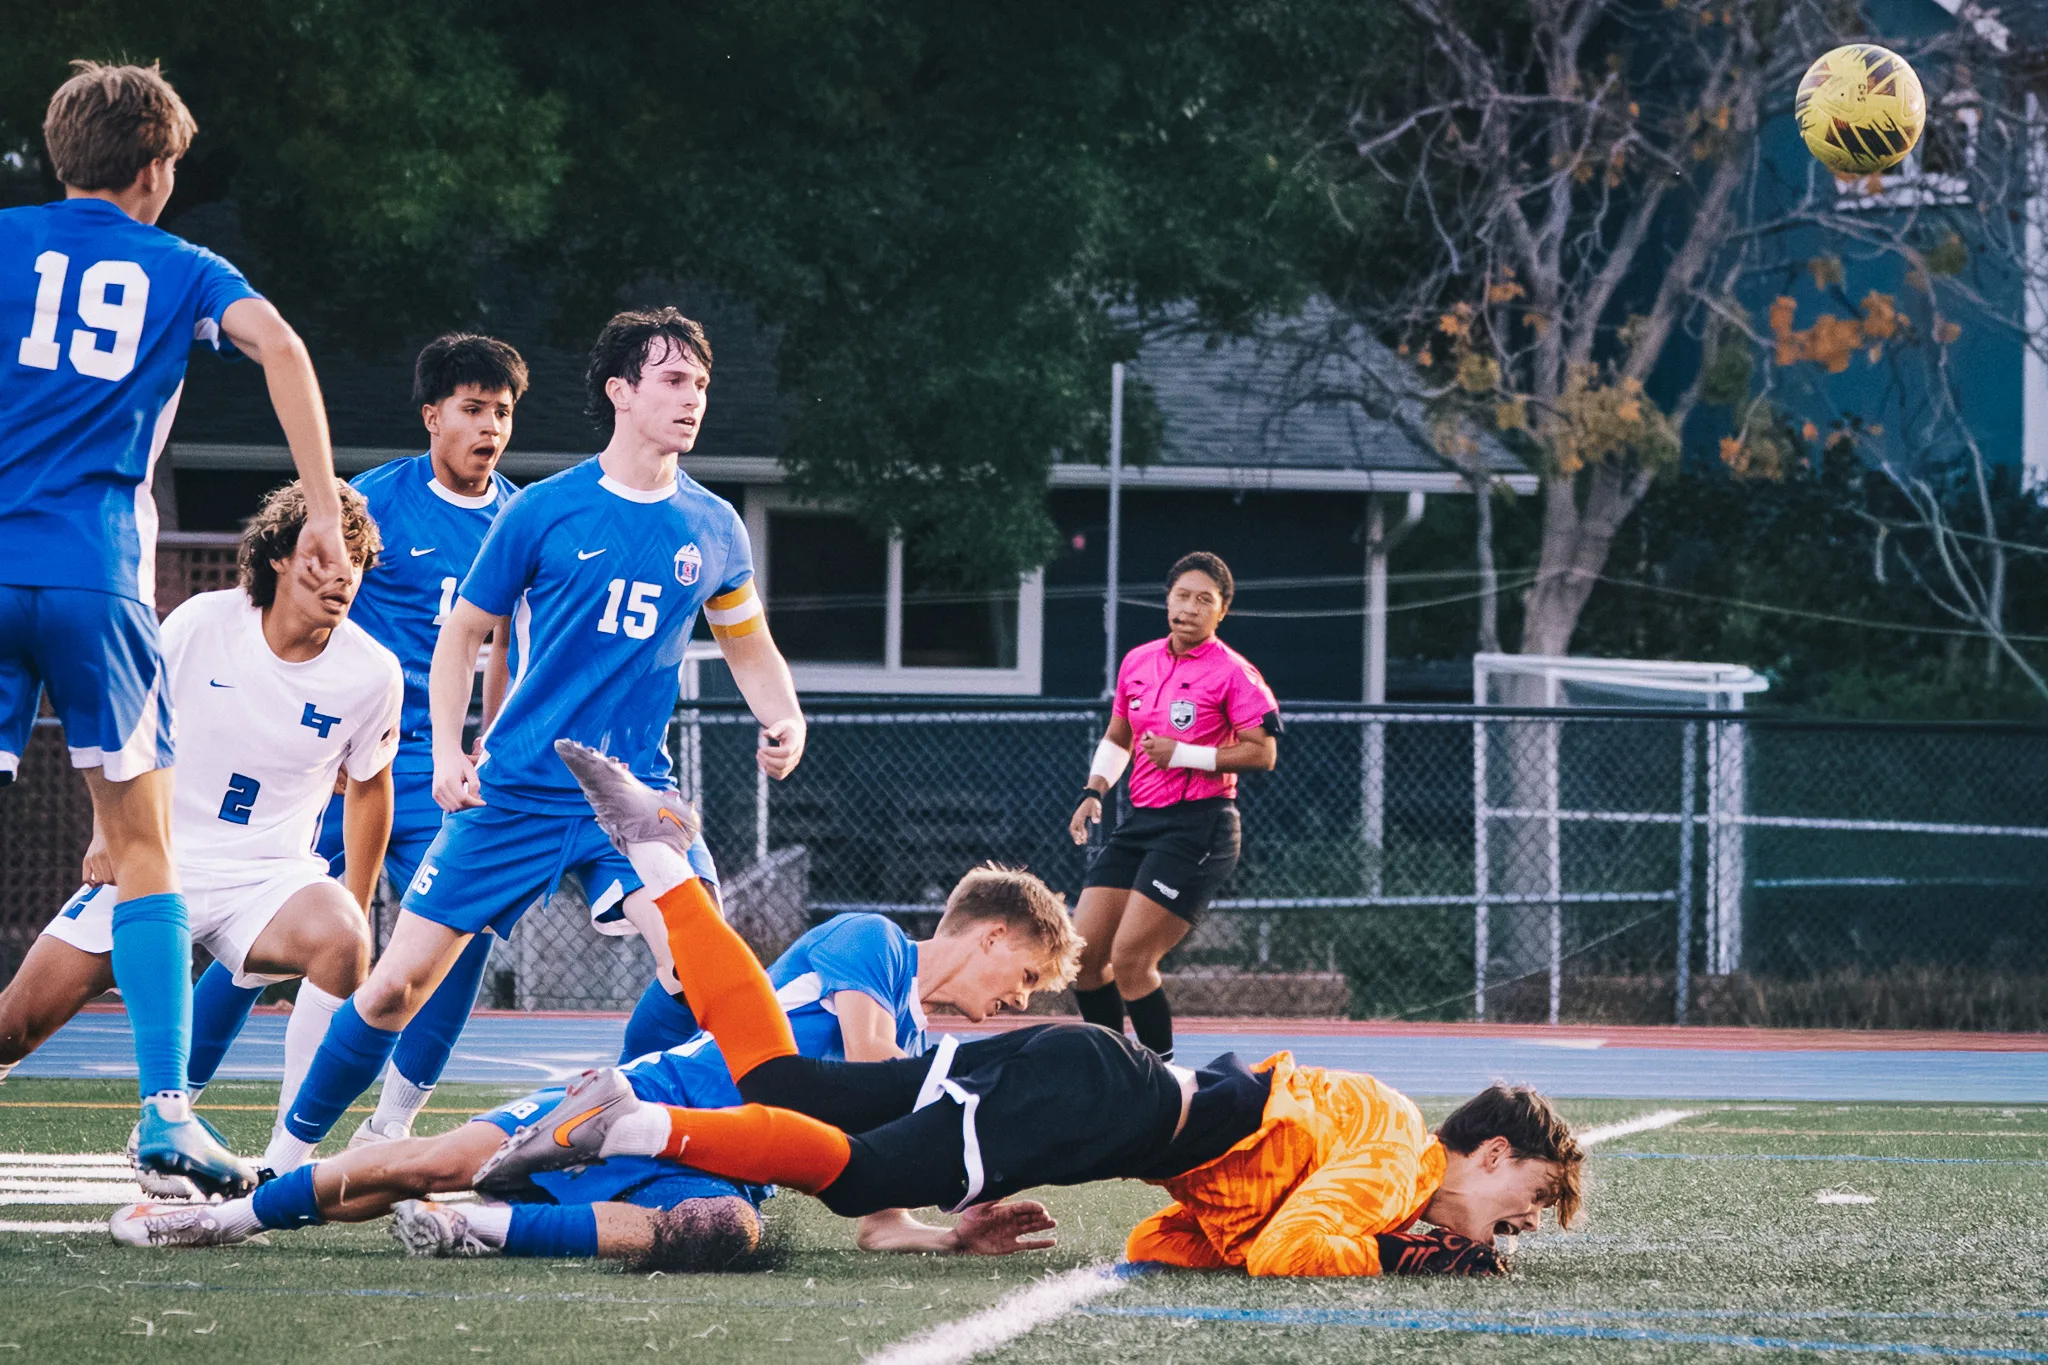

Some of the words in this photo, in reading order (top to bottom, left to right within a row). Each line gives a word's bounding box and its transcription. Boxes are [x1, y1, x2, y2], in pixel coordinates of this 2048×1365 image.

[18, 250, 150, 382] 19
[597, 578, 662, 640] 15
[217, 772, 261, 826] 2
[412, 864, 439, 896] 15
